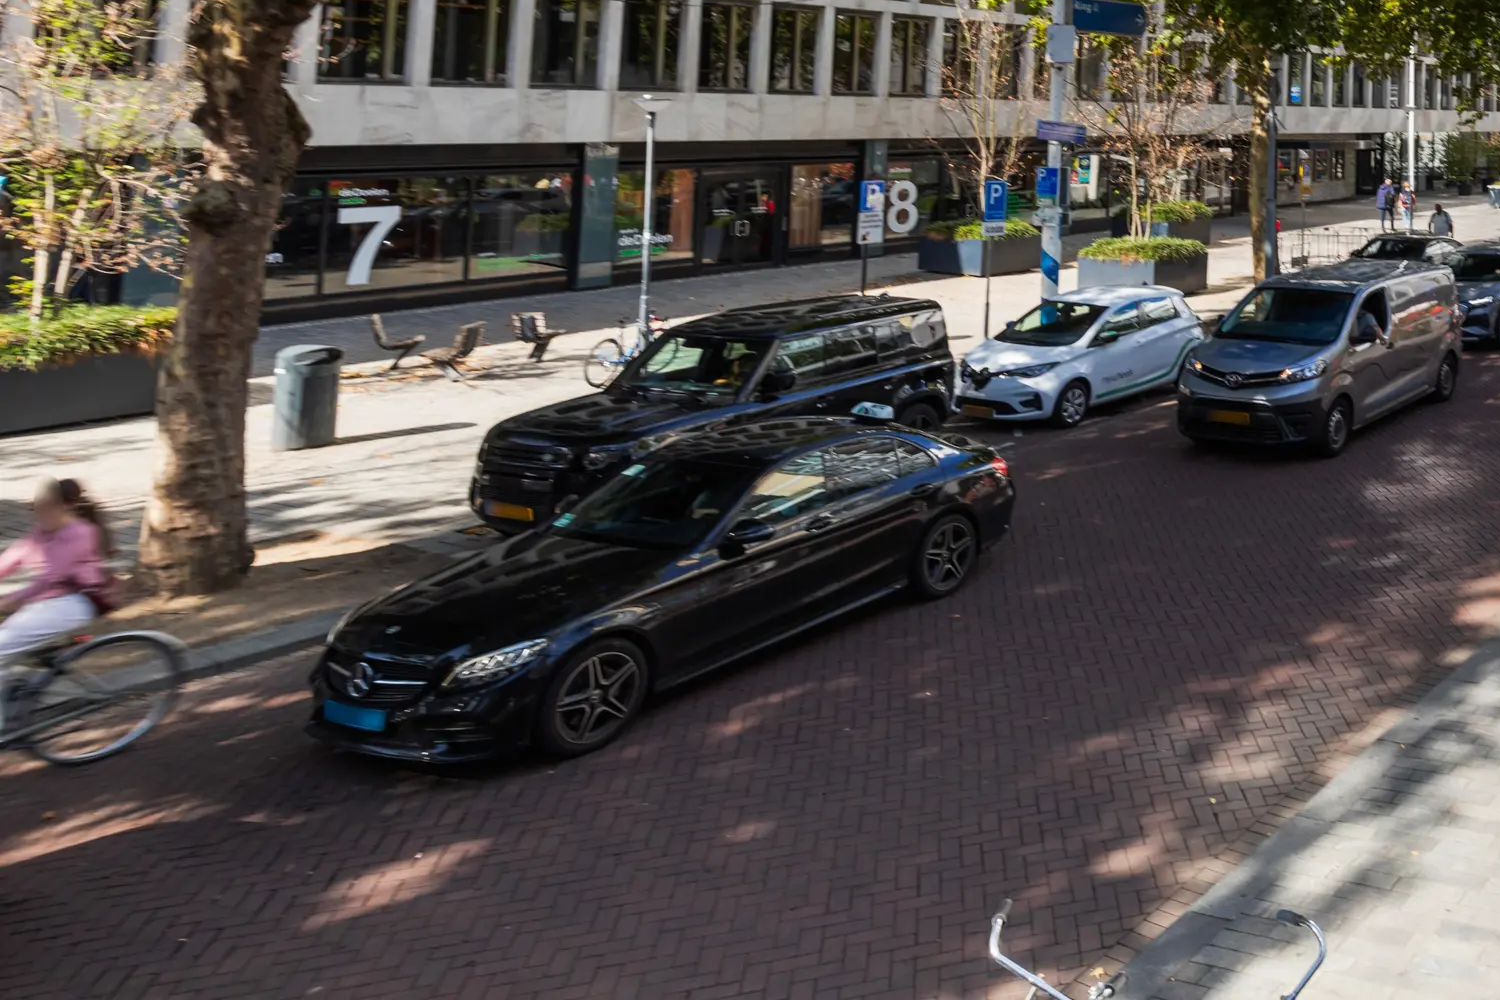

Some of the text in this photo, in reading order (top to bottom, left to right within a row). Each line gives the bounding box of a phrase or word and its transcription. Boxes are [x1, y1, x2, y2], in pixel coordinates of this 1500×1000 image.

[886, 180, 919, 233] 8
[990, 184, 1003, 205] P
[337, 205, 402, 286] 7
